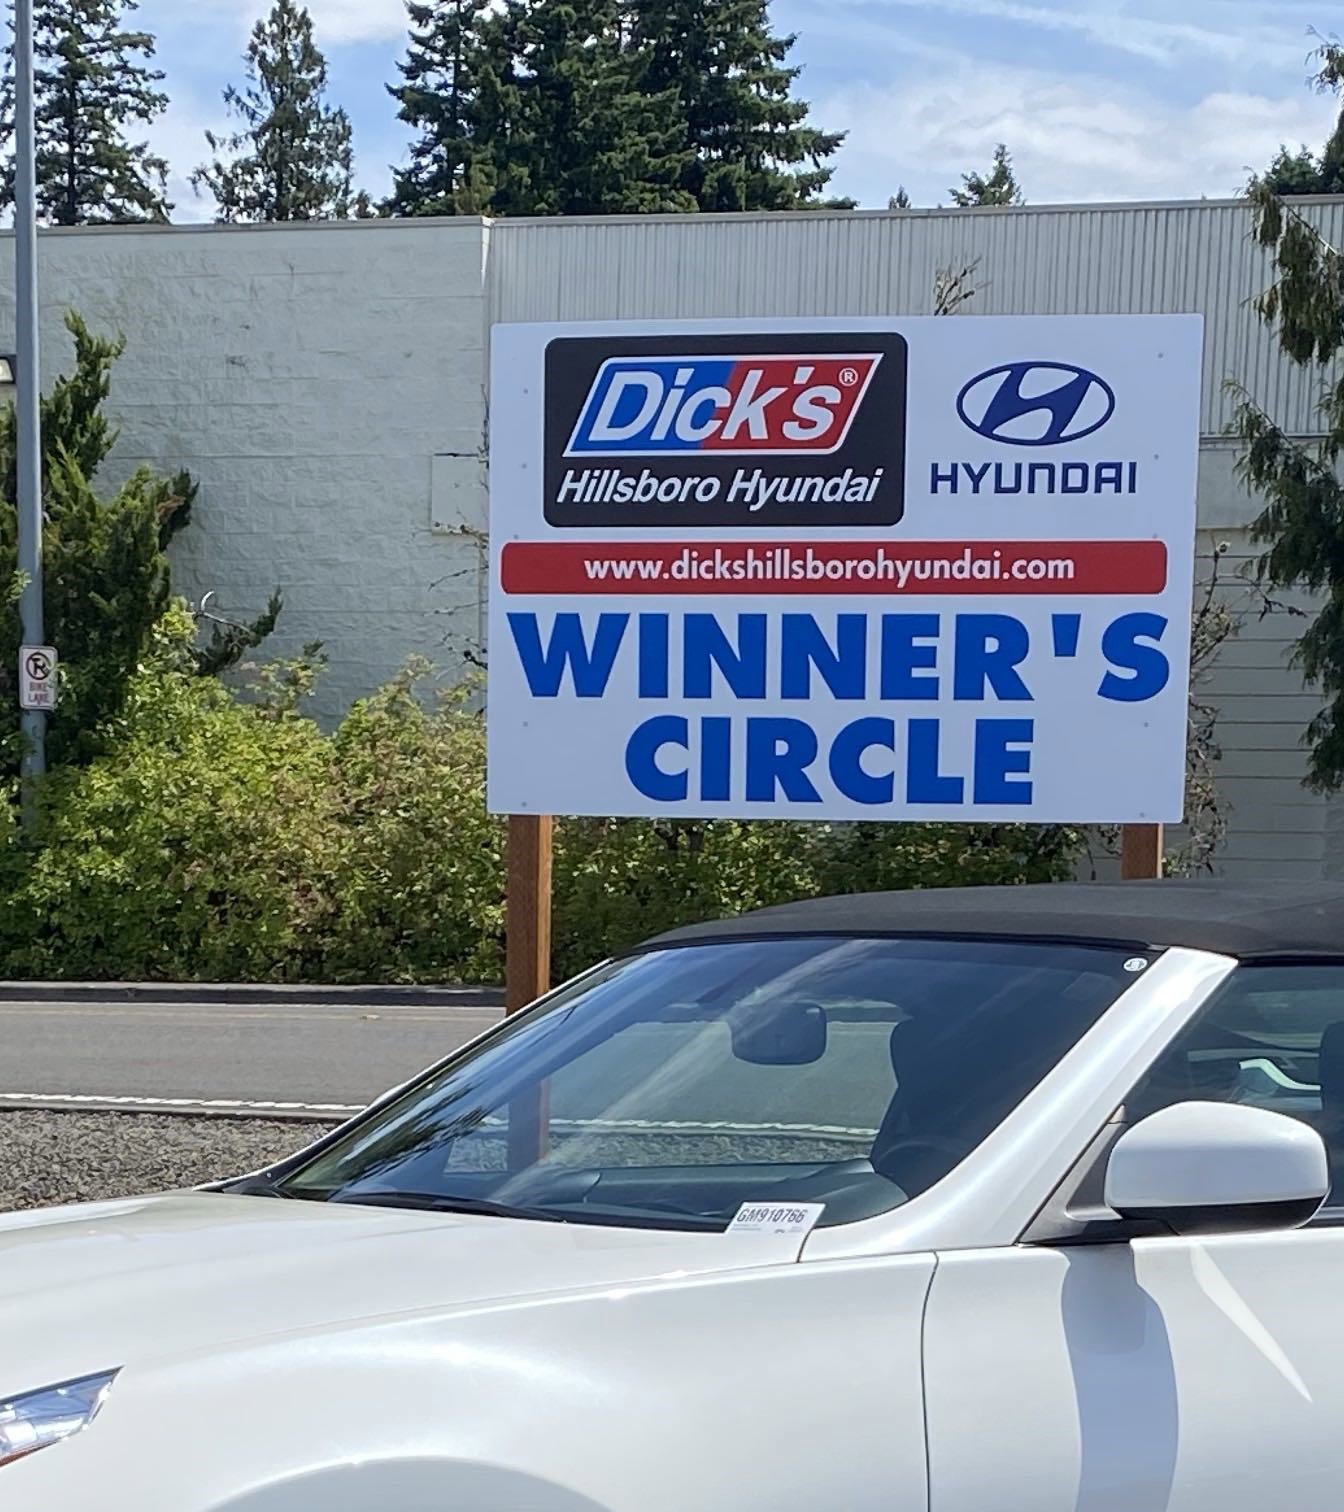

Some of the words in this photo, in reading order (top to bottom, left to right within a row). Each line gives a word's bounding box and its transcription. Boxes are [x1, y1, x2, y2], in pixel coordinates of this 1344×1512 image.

[588, 366, 843, 443] Dick's
[557, 469, 720, 504] Hillsboro
[729, 467, 885, 512] Hyundai
[930, 461, 1137, 495] HYUNDAI
[583, 549, 1075, 589] www.dickshillsborohyundai.com
[506, 611, 1170, 703] WINNER'S
[625, 715, 1034, 806] CIRCLE
